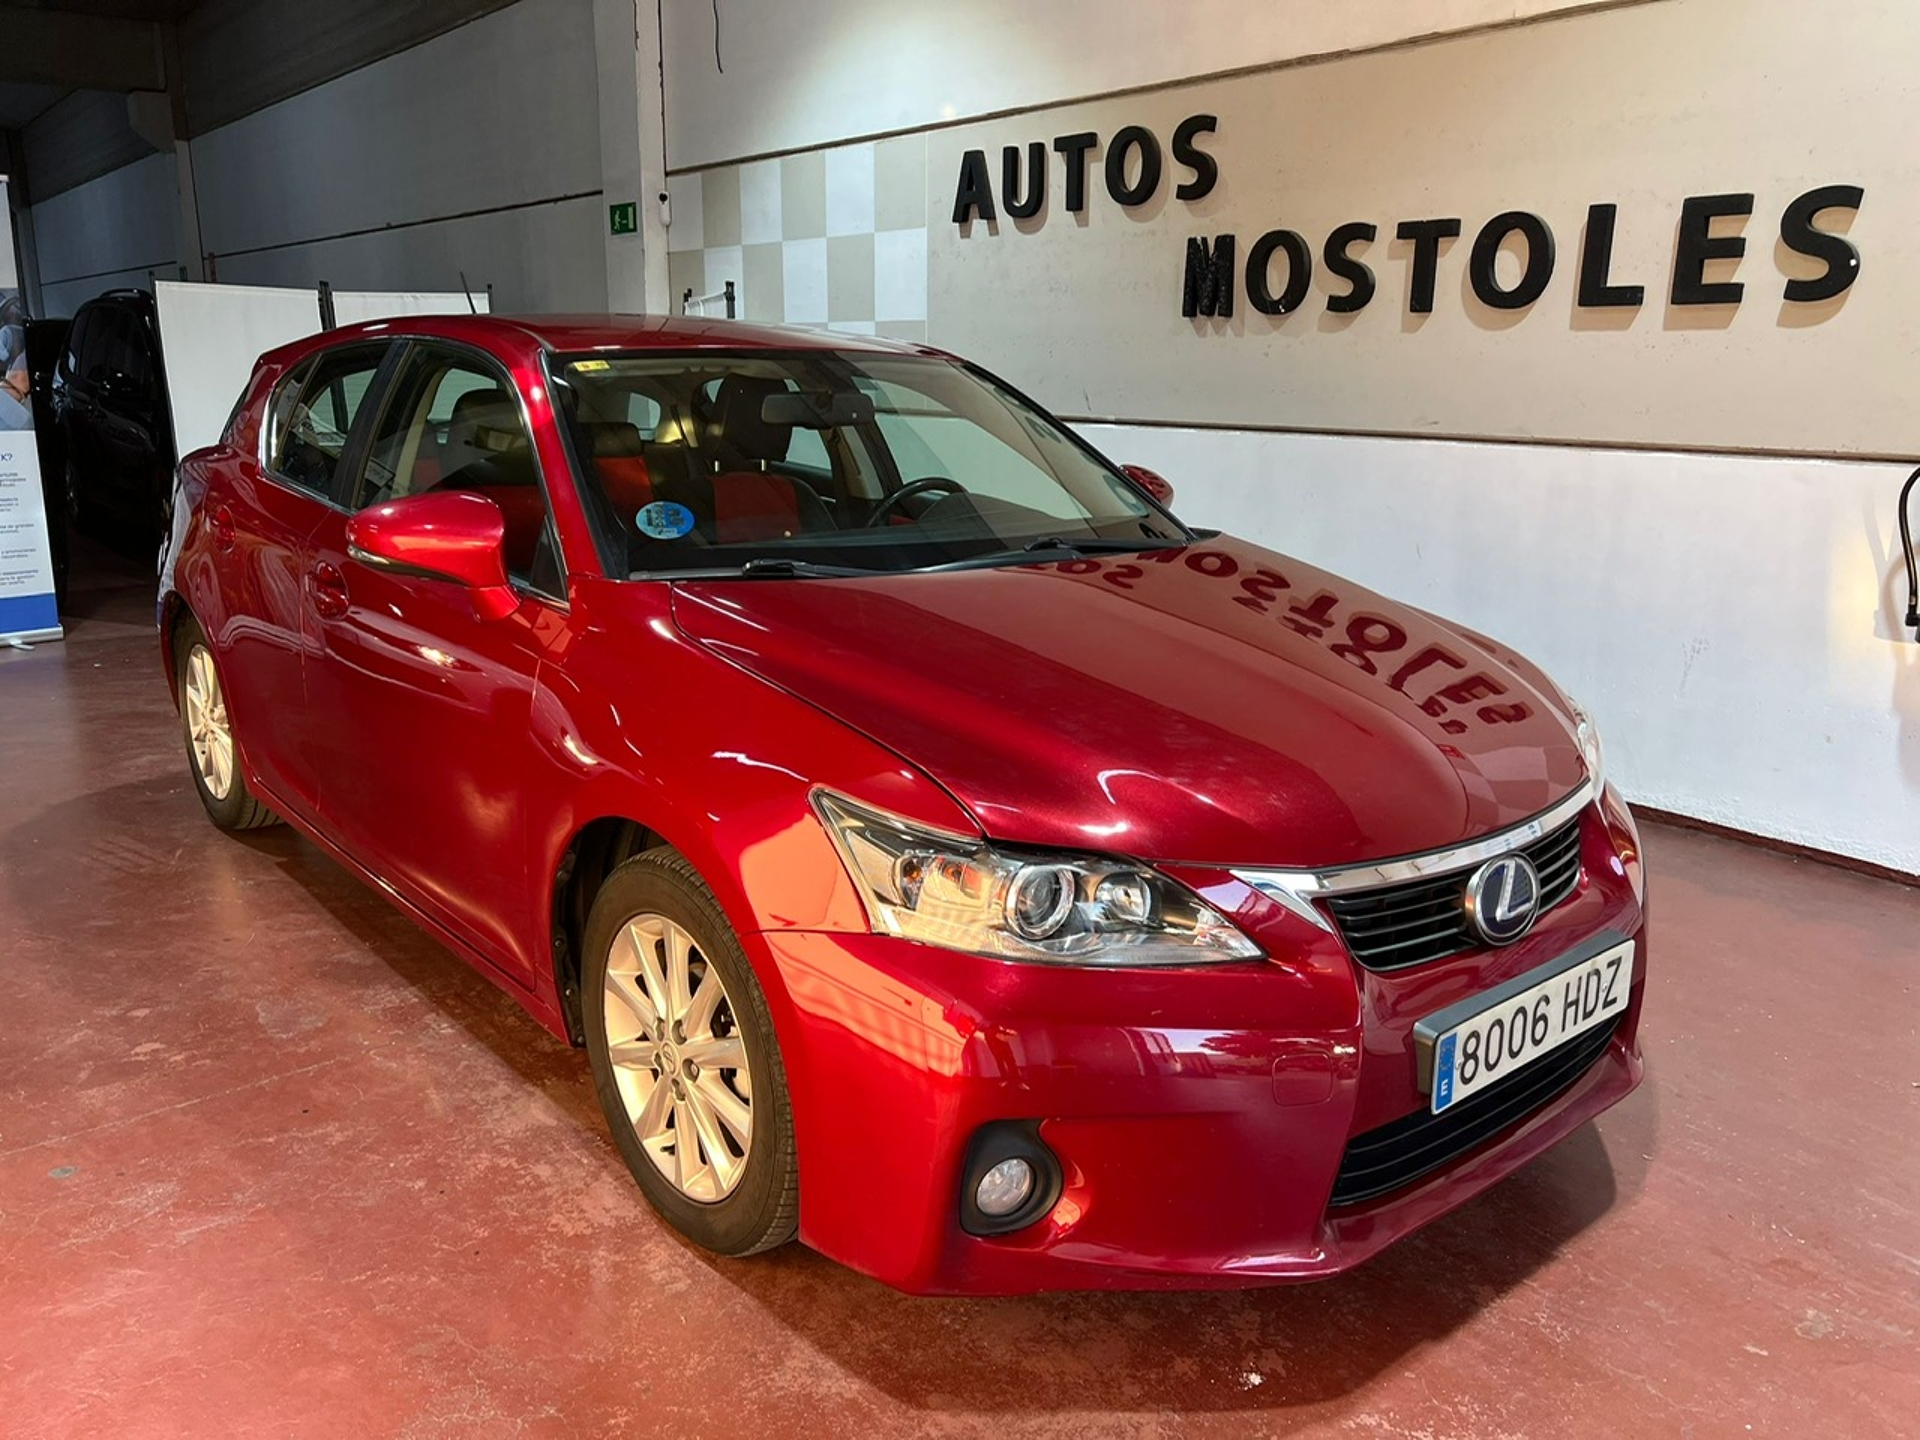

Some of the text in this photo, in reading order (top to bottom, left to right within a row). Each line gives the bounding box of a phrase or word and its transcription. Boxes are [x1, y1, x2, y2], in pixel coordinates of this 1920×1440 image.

[952, 114, 1218, 223] AUTOS
[1182, 185, 1864, 317] MOSTOLES
[1440, 955, 1623, 1096] E 8006 HDZ
